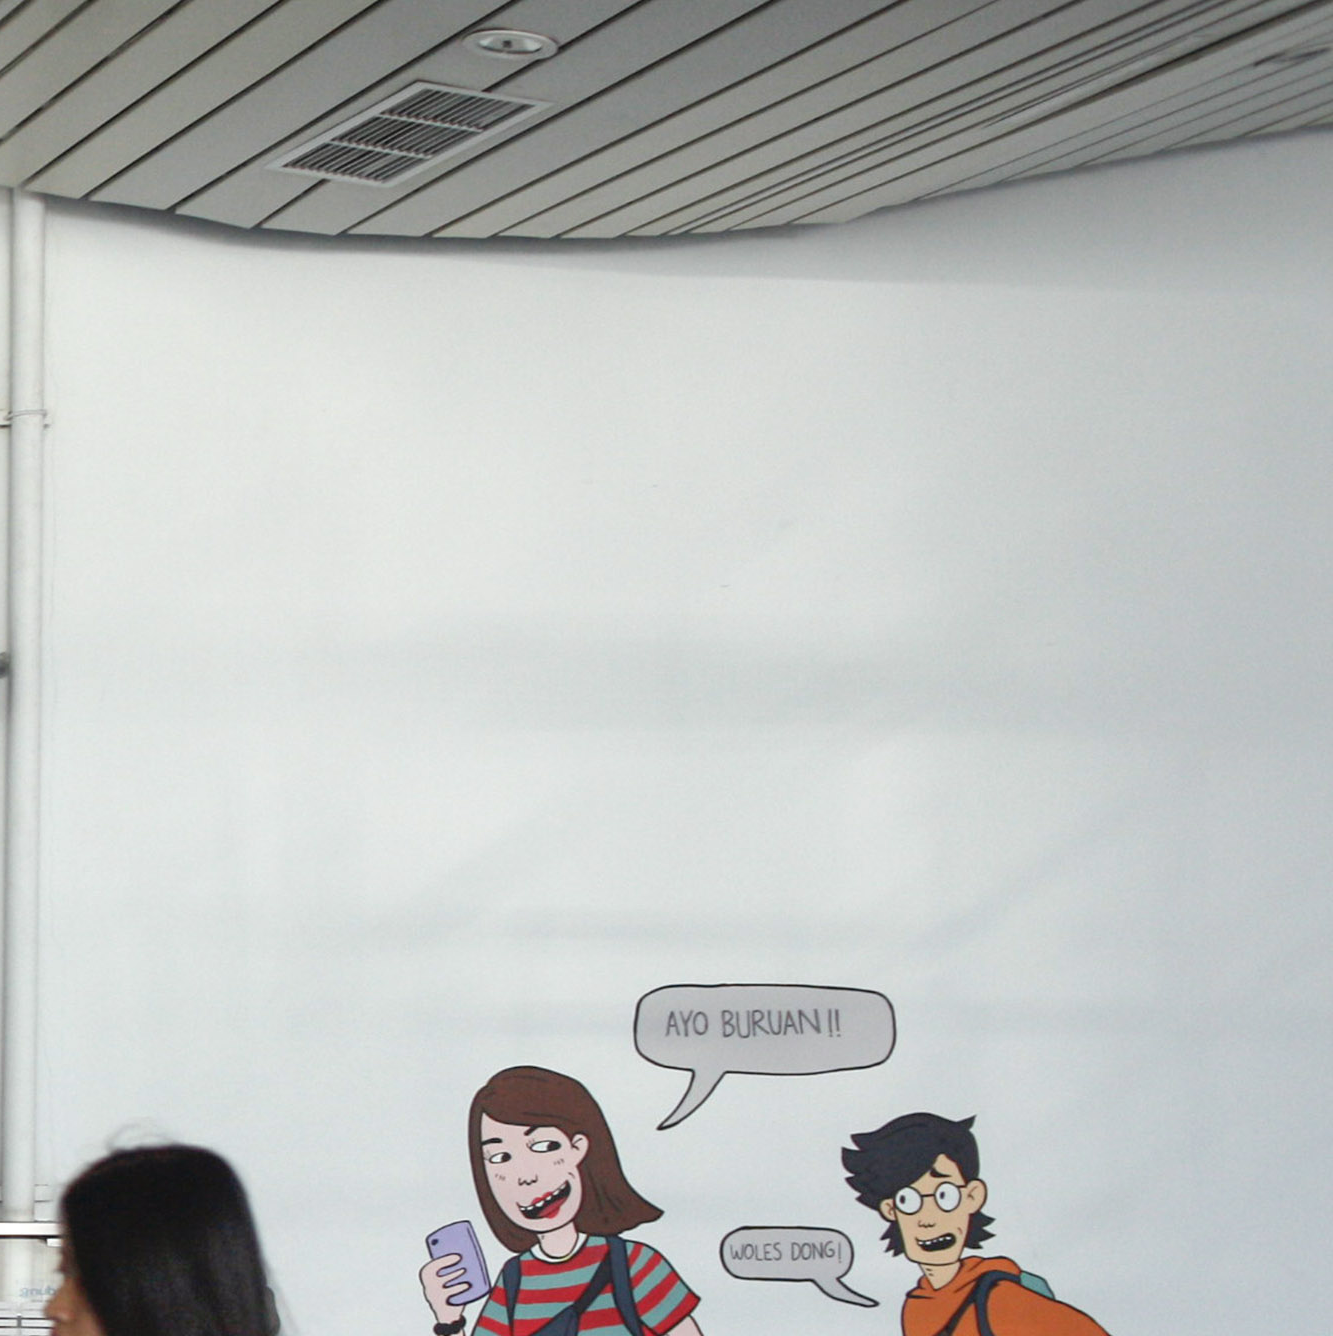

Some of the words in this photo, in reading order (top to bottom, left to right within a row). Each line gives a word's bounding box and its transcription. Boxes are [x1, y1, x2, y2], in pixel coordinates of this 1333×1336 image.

[665, 1009, 709, 1037] AYO
[721, 1008, 842, 1038] BURUAN!!
[729, 1242, 783, 1260] WOLES
[790, 1241, 843, 1264] DONG!
